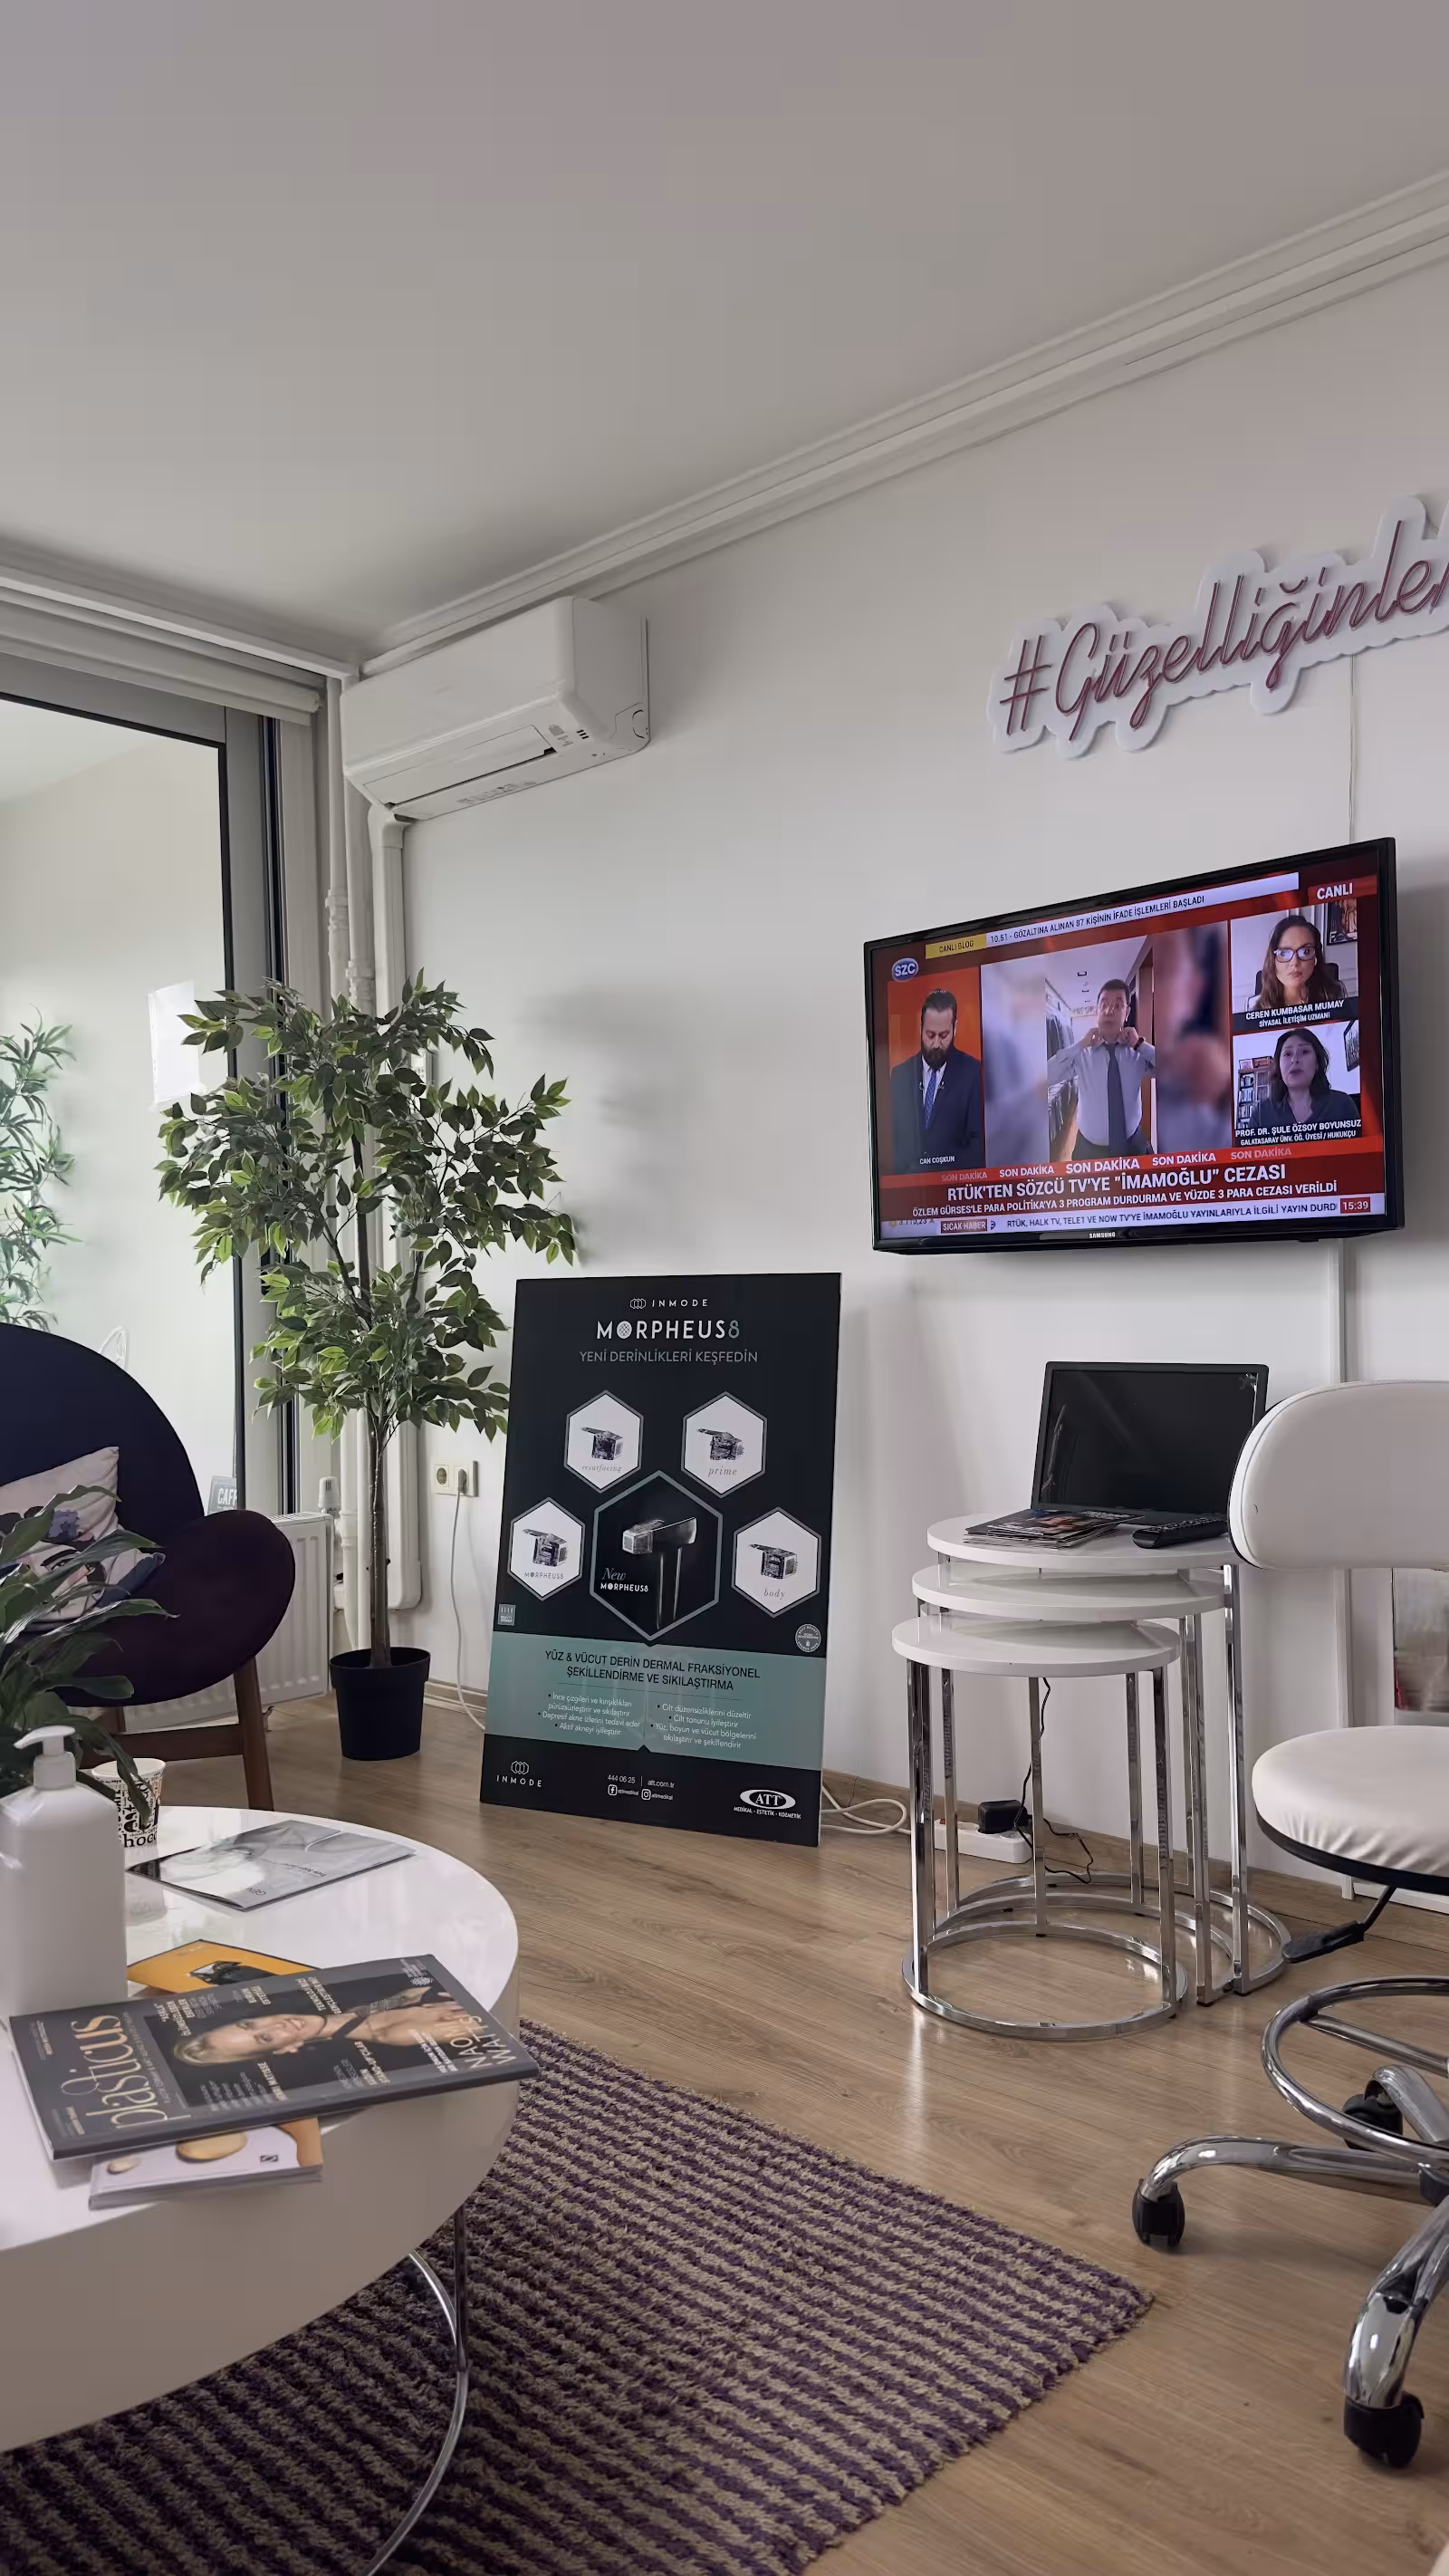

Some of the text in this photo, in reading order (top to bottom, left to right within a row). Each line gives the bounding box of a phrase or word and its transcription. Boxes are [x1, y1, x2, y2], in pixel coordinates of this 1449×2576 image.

[1317, 882, 1353, 900] CANLI
[1013, 926, 1049, 939] GÖZALTINA
[1050, 922, 1075, 933] ALINAN
[1086, 911, 1112, 926] KİŞİNİN
[1113, 908, 1133, 920] İFADE
[1134, 902, 1172, 917] İŞLEMLERİ
[1173, 895, 1204, 909] BAŞLADI
[938, 939, 974, 953] CANLI BLOG
[895, 963, 916, 976] SZC
[1246, 999, 1345, 1020] CEREN KUMBASAR MUMAY
[1259, 1012, 1330, 1028] SİYASAL İLETİŞİM UZMANI
[1235, 1119, 1362, 1138] PROF. DR. ŞULE ÖZSOY BOYUNSUZ
[1240, 1138, 1279, 1146] GALATASARAY
[1280, 1134, 1293, 1143] ÜNV.
[1305, 1131, 1323, 1140] ÜYESİ
[1327, 1129, 1357, 1139] HUKUKÇU
[919, 1155, 955, 1165] CAN COŞKUN
[1152, 1152, 1217, 1167] SON DAKİKA
[1231, 1146, 1292, 1160] SON DAKİKA
[999, 1165, 1055, 1178] SON DAKİKA
[1065, 1157, 1140, 1175] SON DAKİKA
[941, 1170, 988, 1182] SON DAKİKA
[947, 1181, 1013, 1201] RTÜK'TEN
[1016, 1177, 1065, 1197] SÖZCÜ
[1068, 1176, 1110, 1193] TV'YE
[1223, 1164, 1286, 1183] CEZASI
[913, 1179, 1338, 1216] ÖZLEM GÜRSES'LE PARA POLİTİKA'YA 3 PROGRAM DURDURMA VE YÜZDE 3 PARA CEZASI VERİLDİ
[943, 1201, 1369, 1231] SICAK HABER RTÜK, HALK TV, TELE1 VE NOW TV'YE İMAMOĞLU YAYINLARIYLA İLGİLİ YAYIN 15:39
[651, 1298, 708, 1308] INMODE
[596, 1319, 740, 1340] MORPHEUS8
[579, 1348, 759, 1365] YENİ DERİNLİKLERİ KEŞFEDİN
[707, 1466, 738, 1476] prime
[523, 1572, 564, 1580] MORPHEUS8
[601, 1567, 627, 1581] New
[600, 1582, 649, 1592] MORPHEUS8
[763, 1588, 786, 1600] body
[545, 1649, 761, 1678] YÜZ & VÜCUT DERİN DERMAL FRAKSİYONEL
[566, 1666, 734, 1690] ŞEKİLLENDİRME VE SIKILAŞTIRMA
[662, 1703, 673, 1712] Cilt
[726, 1709, 752, 1719] düzeltir
[542, 1710, 568, 1720] Depresif
[605, 1717, 625, 1726] tedavi
[625, 1719, 641, 1728] eder
[673, 1714, 685, 1723] Cilt
[686, 1717, 710, 1725] tonunu
[669, 1724, 690, 1734] boyun
[701, 1727, 720, 1736] vücut
[496, 1774, 542, 1787] INMODE
[607, 1774, 619, 1783] 444
[628, 1775, 636, 1783] 25
[754, 1793, 782, 1806] ATT
[756, 1808, 775, 1816] ESTETİK
[460, 2015, 517, 2065] WATTS
[61, 2014, 192, 2129] plasticus
[257, 2061, 278, 2086] MATISSE
